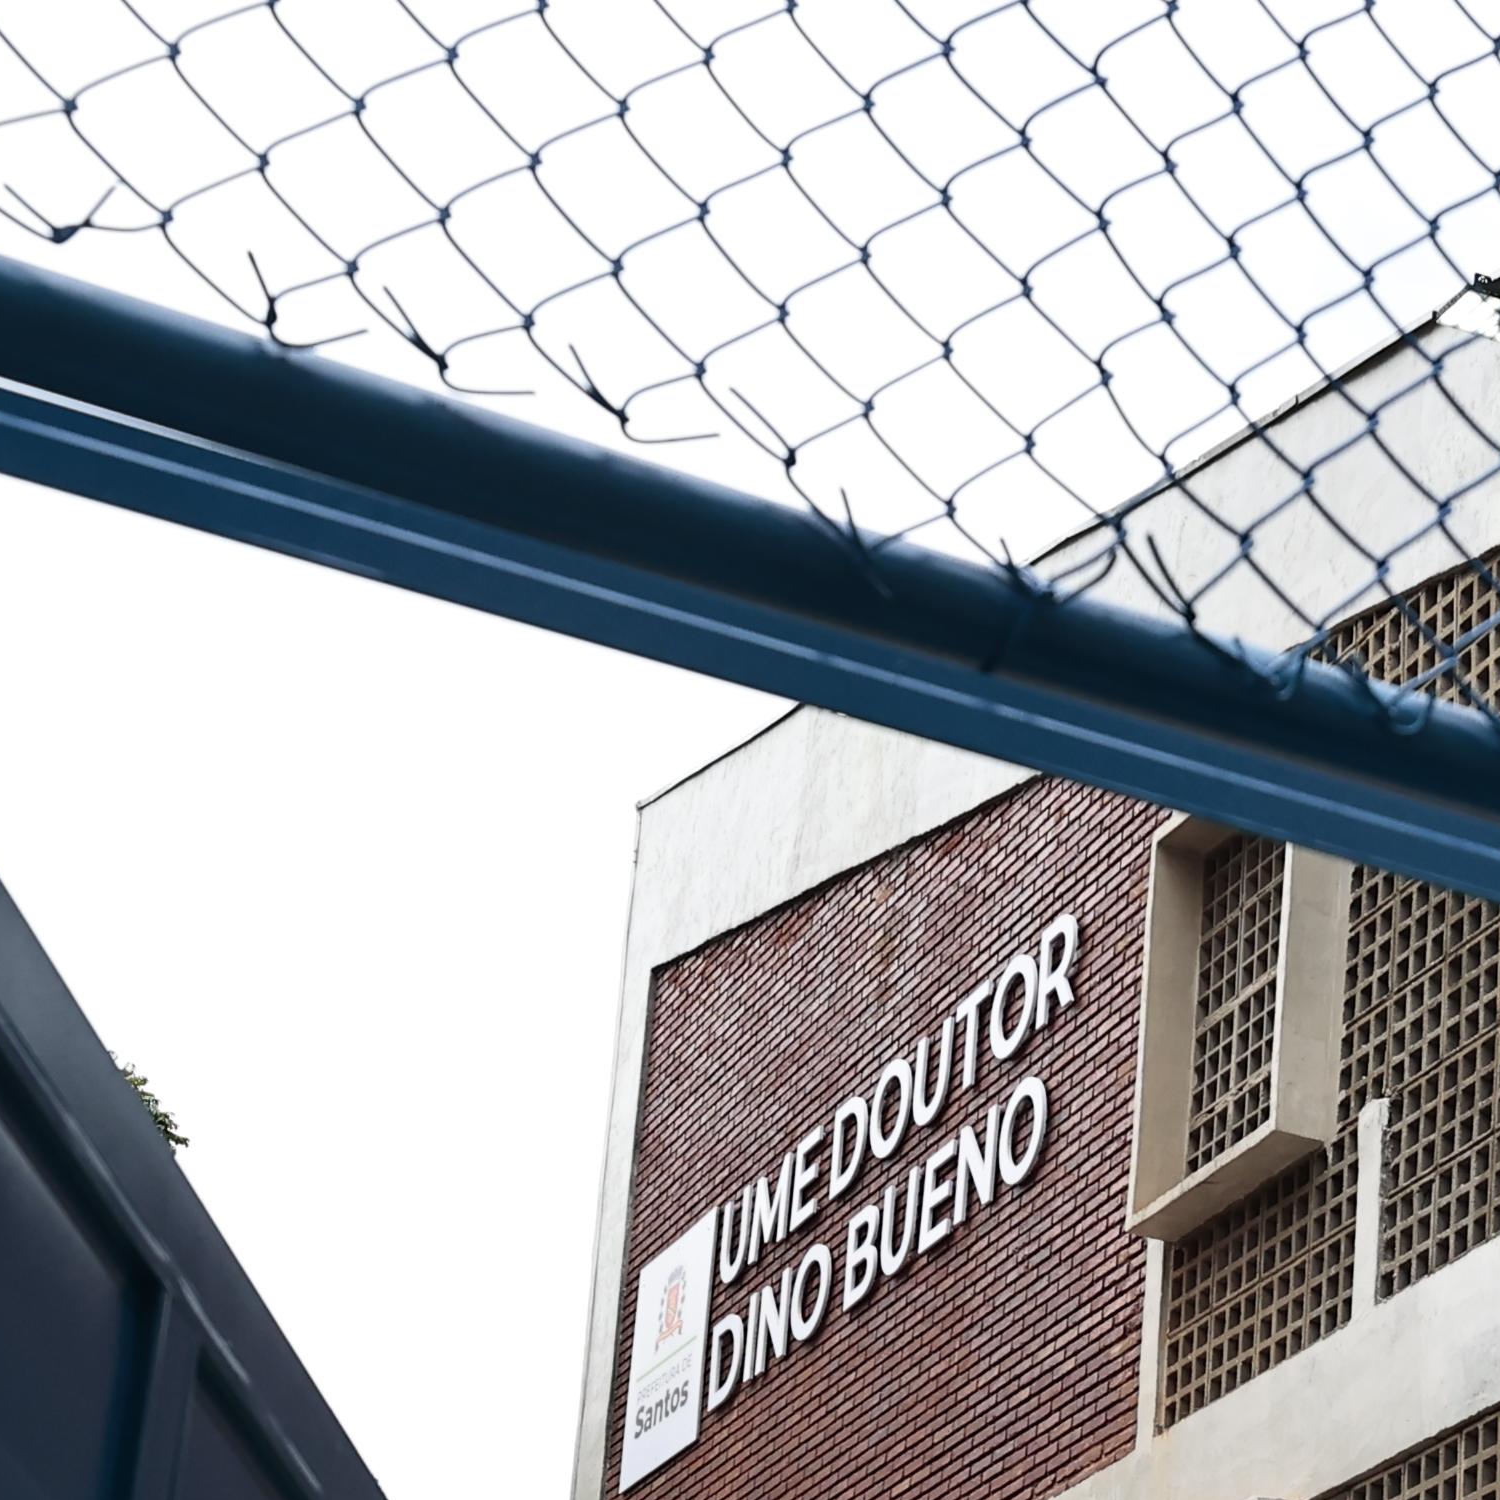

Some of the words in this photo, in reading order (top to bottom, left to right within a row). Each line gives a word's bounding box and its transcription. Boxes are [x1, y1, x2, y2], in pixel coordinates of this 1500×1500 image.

[707, 1244, 833, 1411] DINO
[843, 1077, 1047, 1312] BUENO
[719, 1126, 824, 1285] UME
[829, 914, 1080, 1198] DOUTOR
[634, 1380, 689, 1439] Santos
